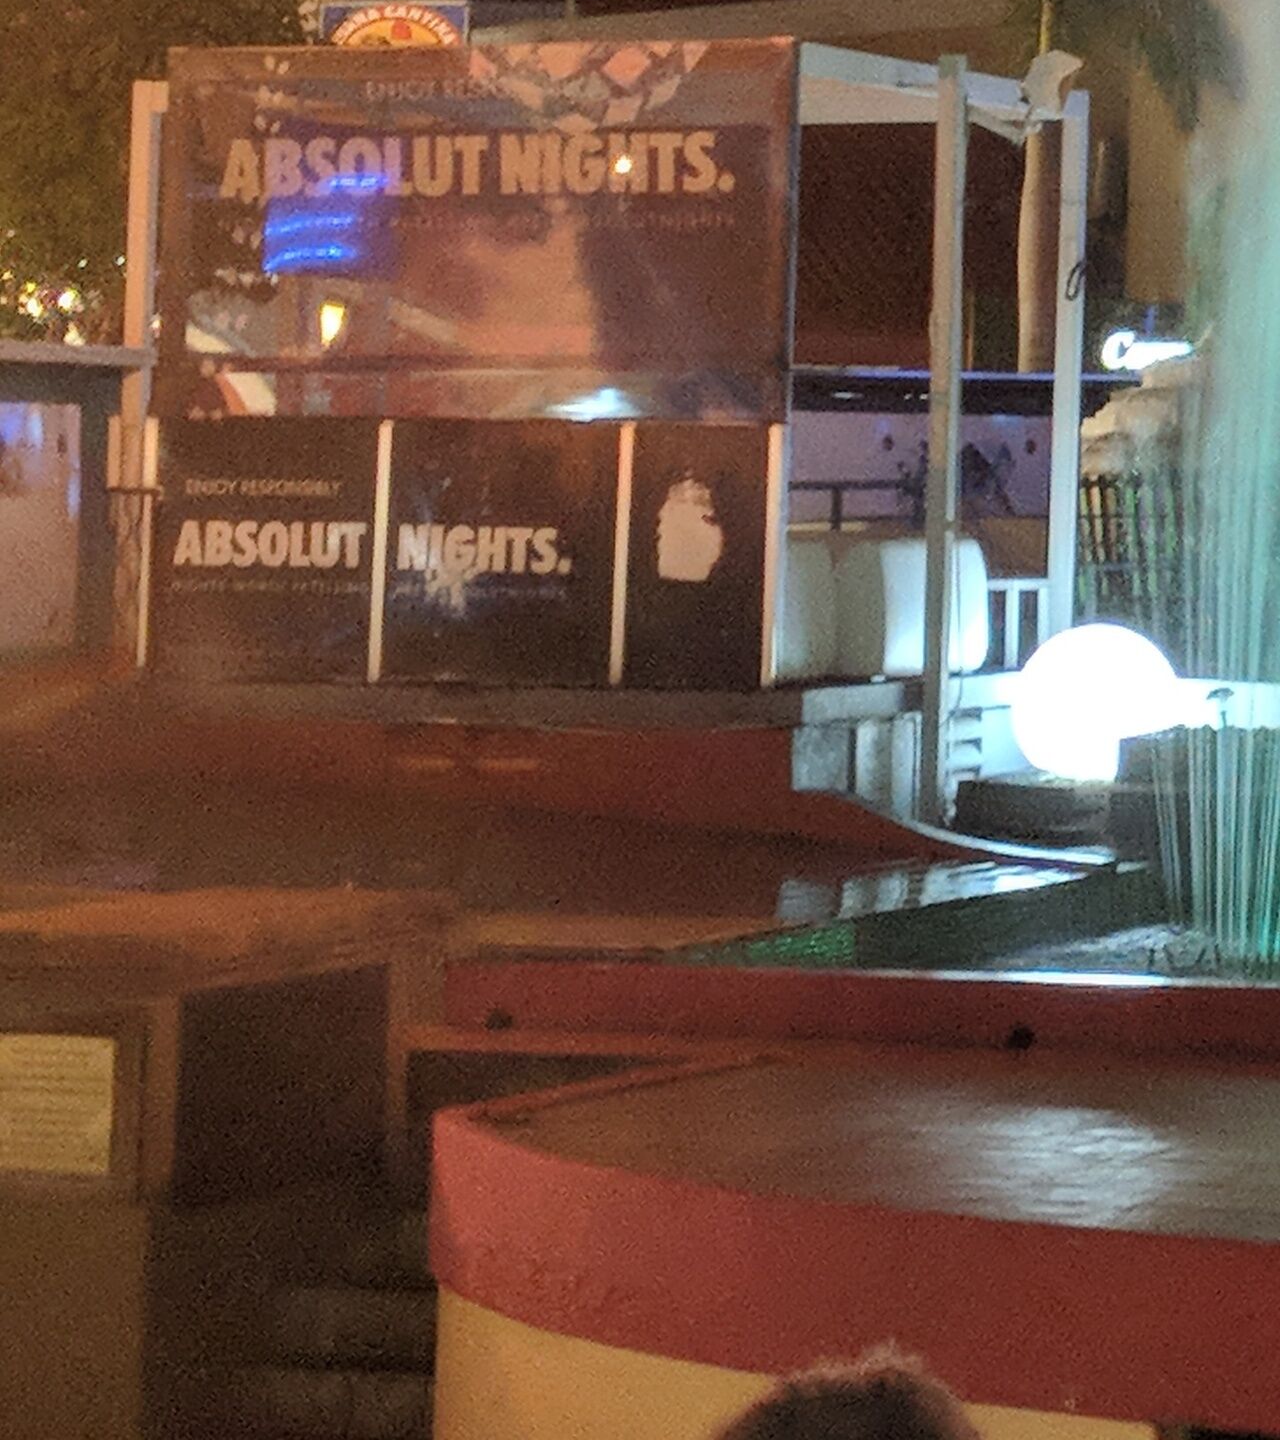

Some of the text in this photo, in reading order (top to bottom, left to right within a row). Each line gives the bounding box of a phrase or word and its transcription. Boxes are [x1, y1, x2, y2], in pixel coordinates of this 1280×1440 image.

[219, 135, 489, 204] ABSOLUT
[172, 519, 368, 569] ABSOLUT
[397, 522, 573, 576] NIGHTS.
